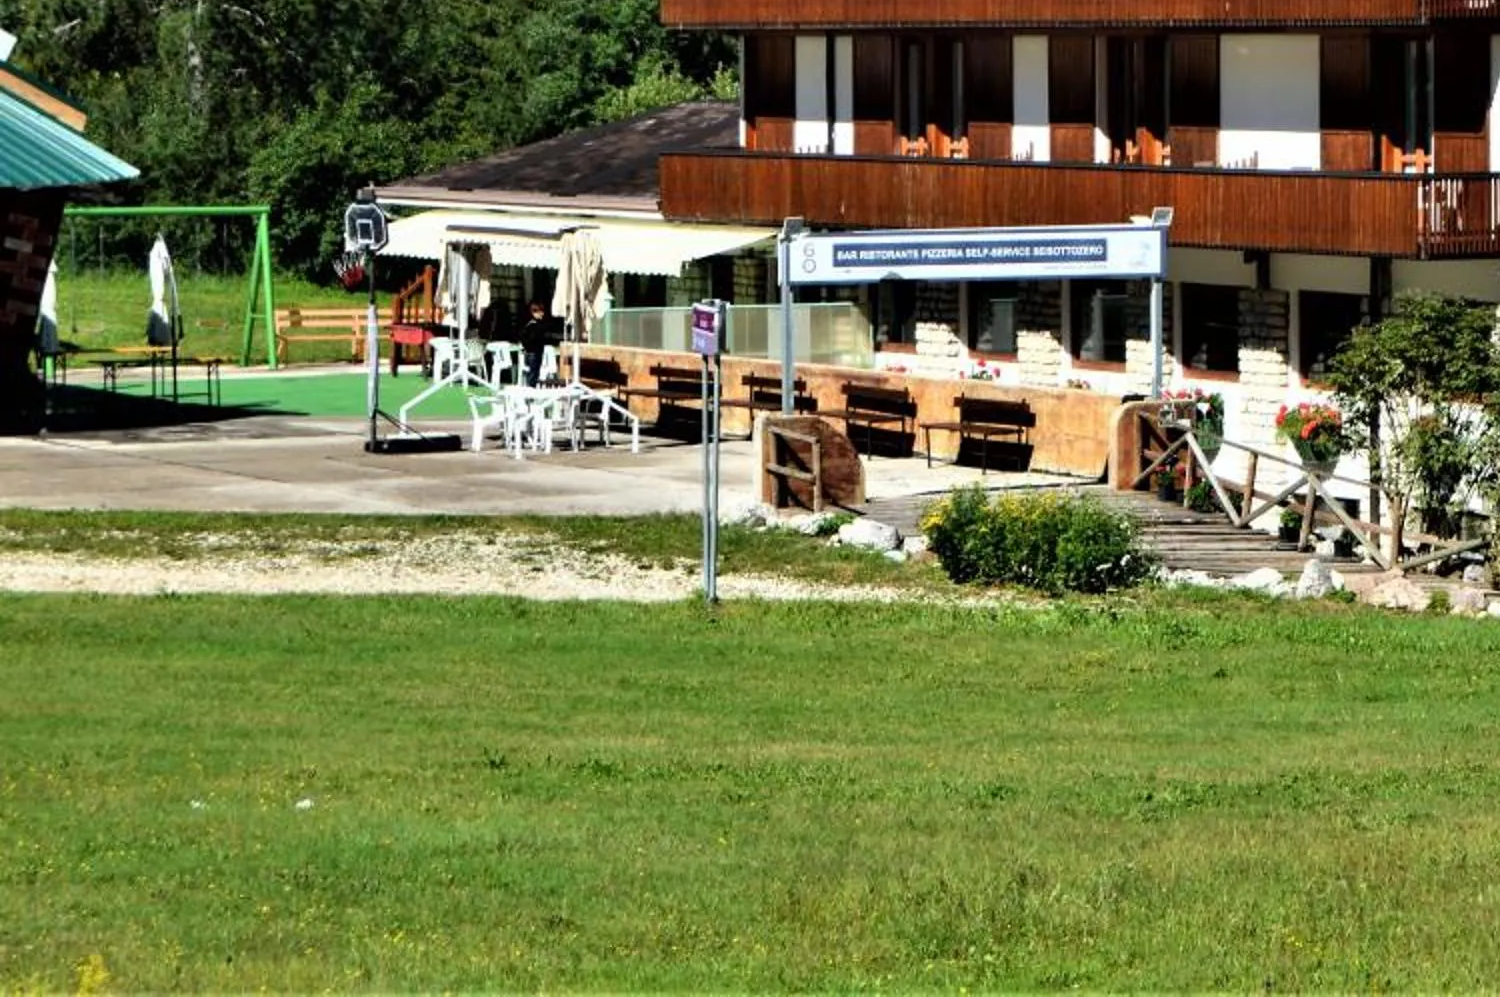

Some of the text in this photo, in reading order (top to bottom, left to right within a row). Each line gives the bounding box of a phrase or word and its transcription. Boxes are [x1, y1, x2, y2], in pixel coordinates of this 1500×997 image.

[837, 250, 858, 260] BAR
[860, 249, 918, 259] RISTORANTE
[921, 248, 962, 258] PIZZERIA
[965, 247, 1030, 258] SELF-SERVICE
